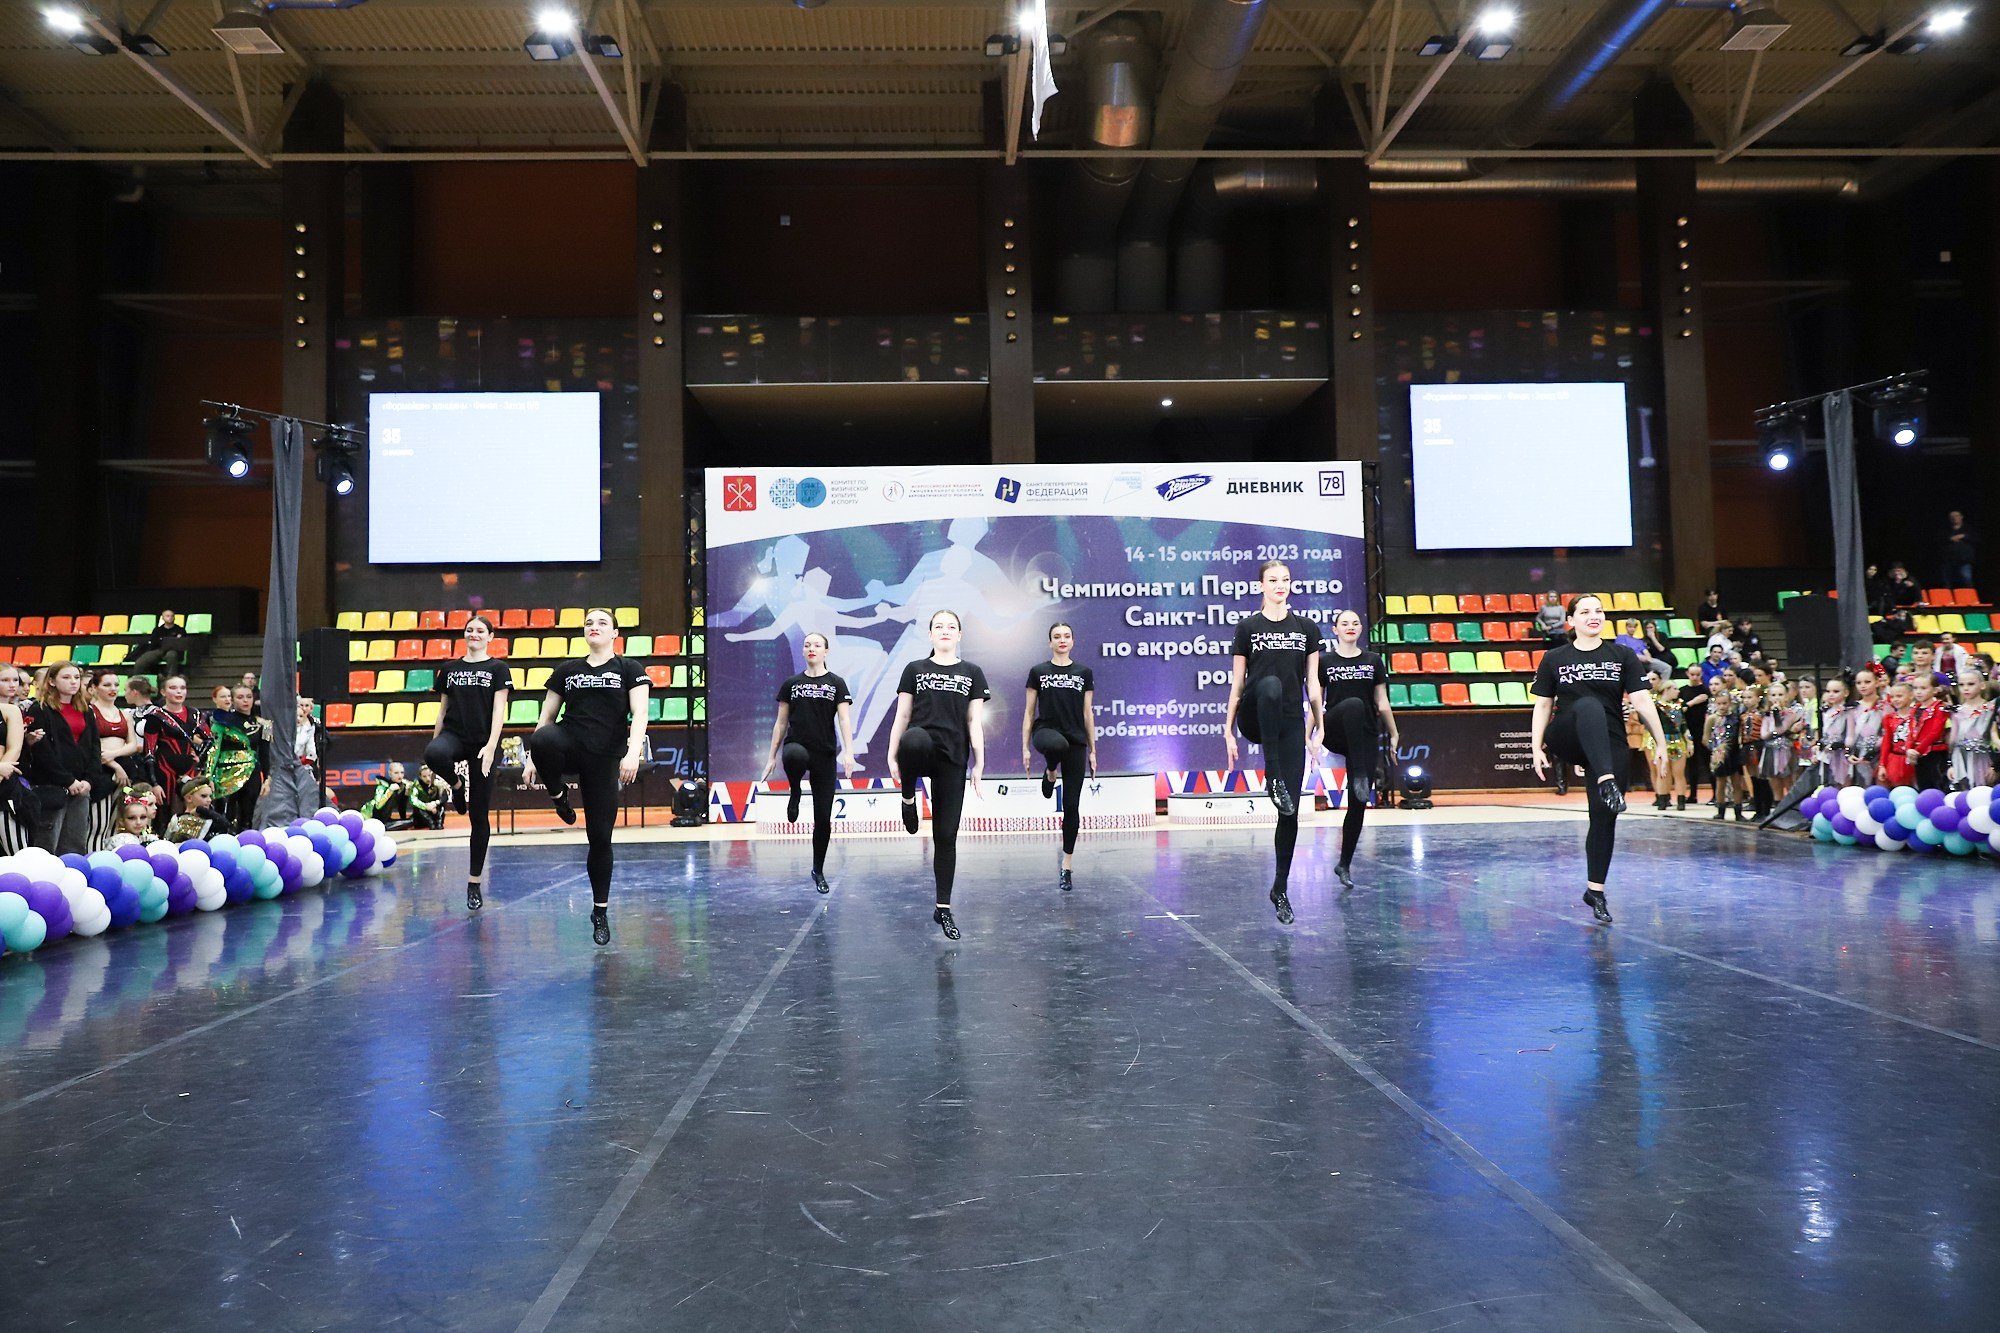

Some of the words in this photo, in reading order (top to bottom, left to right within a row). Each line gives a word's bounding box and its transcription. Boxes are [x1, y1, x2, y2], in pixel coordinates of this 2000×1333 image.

[382, 428, 401, 444] 35
[1226, 481, 1304, 494] ДНЕВНИК
[1323, 476, 1341, 491] 78
[1026, 487, 1088, 497] ФЕДЕРАЦИЯ
[1124, 546, 1145, 562] 14
[1158, 546, 1177, 561] 15
[1180, 546, 1253, 564] октября
[1256, 544, 1299, 561] 2023
[1302, 547, 1343, 561] года
[1042, 577, 1175, 598] Чемпионат
[1180, 581, 1195, 596] и
[1202, 574, 1343, 600] Первство
[1251, 631, 1307, 643] CHARLIES
[1102, 641, 1132, 657] по
[1252, 641, 1306, 653] ANGELS
[1558, 661, 1622, 675] CHARLIES
[1559, 671, 1621, 684] ANGELS
[916, 680, 970, 696] ANGELS
[325, 763, 386, 787] eed
[1053, 784, 1065, 813] 1
[834, 798, 847, 819] 2
[1246, 799, 1255, 815] 3
